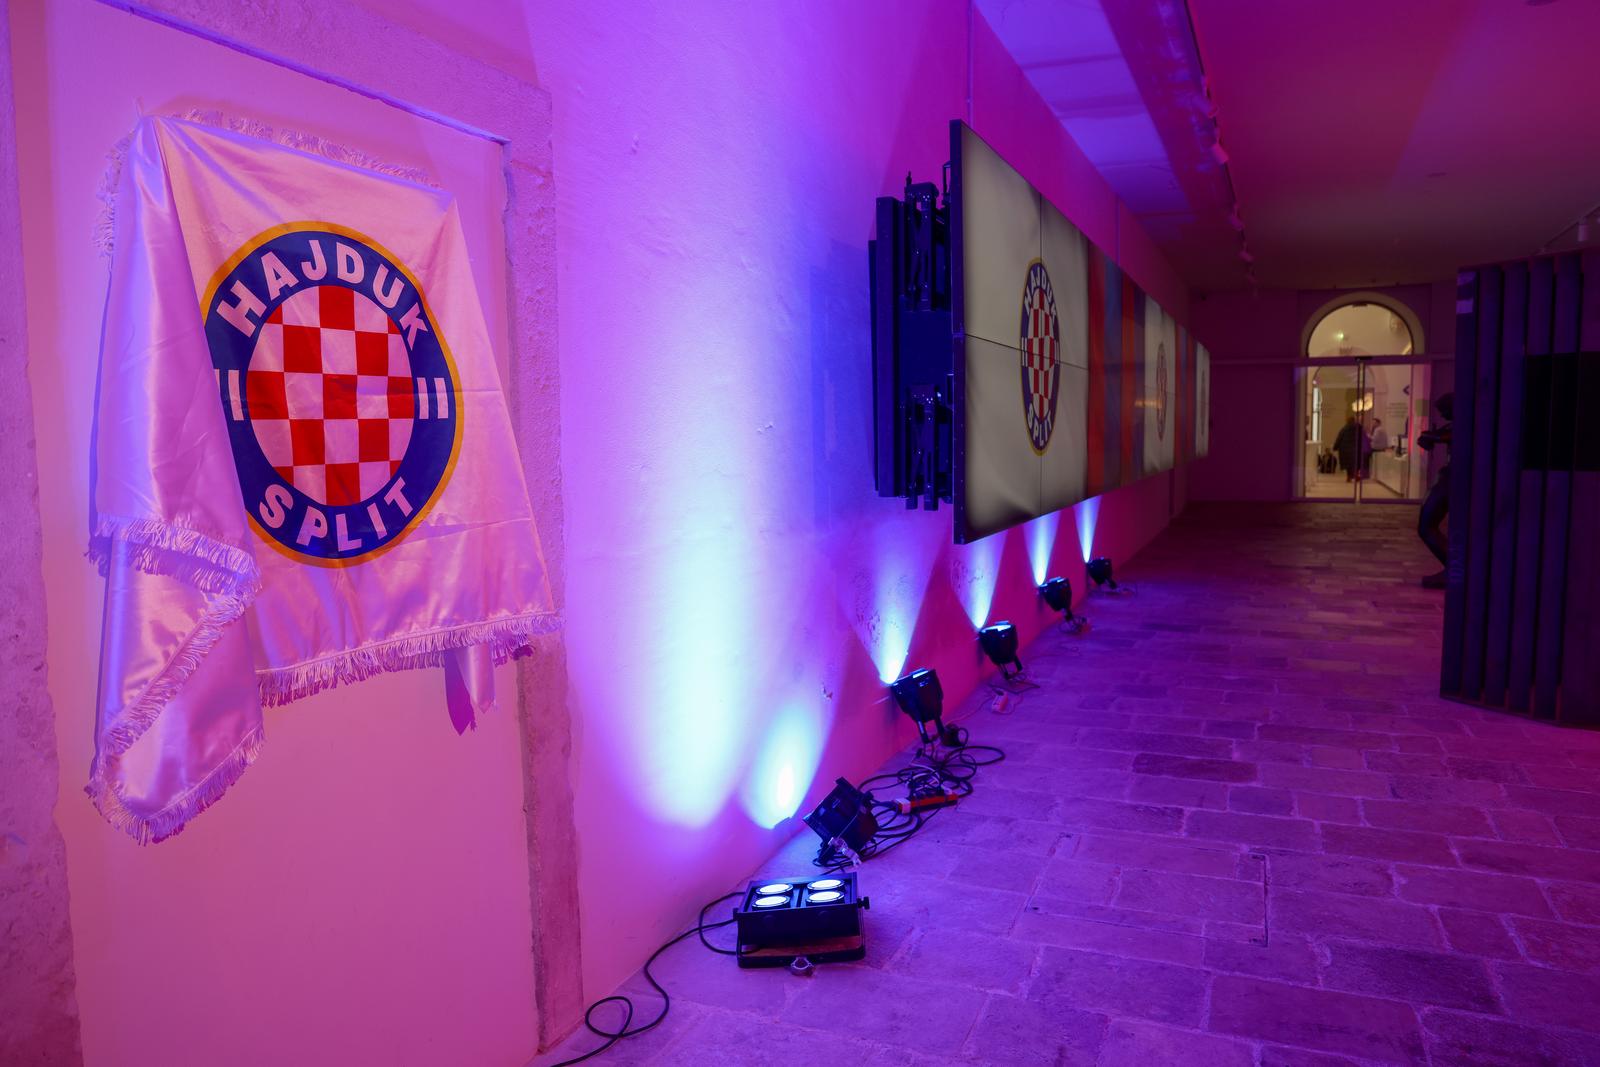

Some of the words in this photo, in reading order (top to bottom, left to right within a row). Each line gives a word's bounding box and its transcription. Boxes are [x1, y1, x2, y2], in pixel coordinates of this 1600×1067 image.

[216, 239, 428, 350] HAJDUK
[1024, 266, 1056, 323] HAJDUK
[1028, 402, 1052, 446] SPLIT
[259, 477, 414, 552] SPLIT
